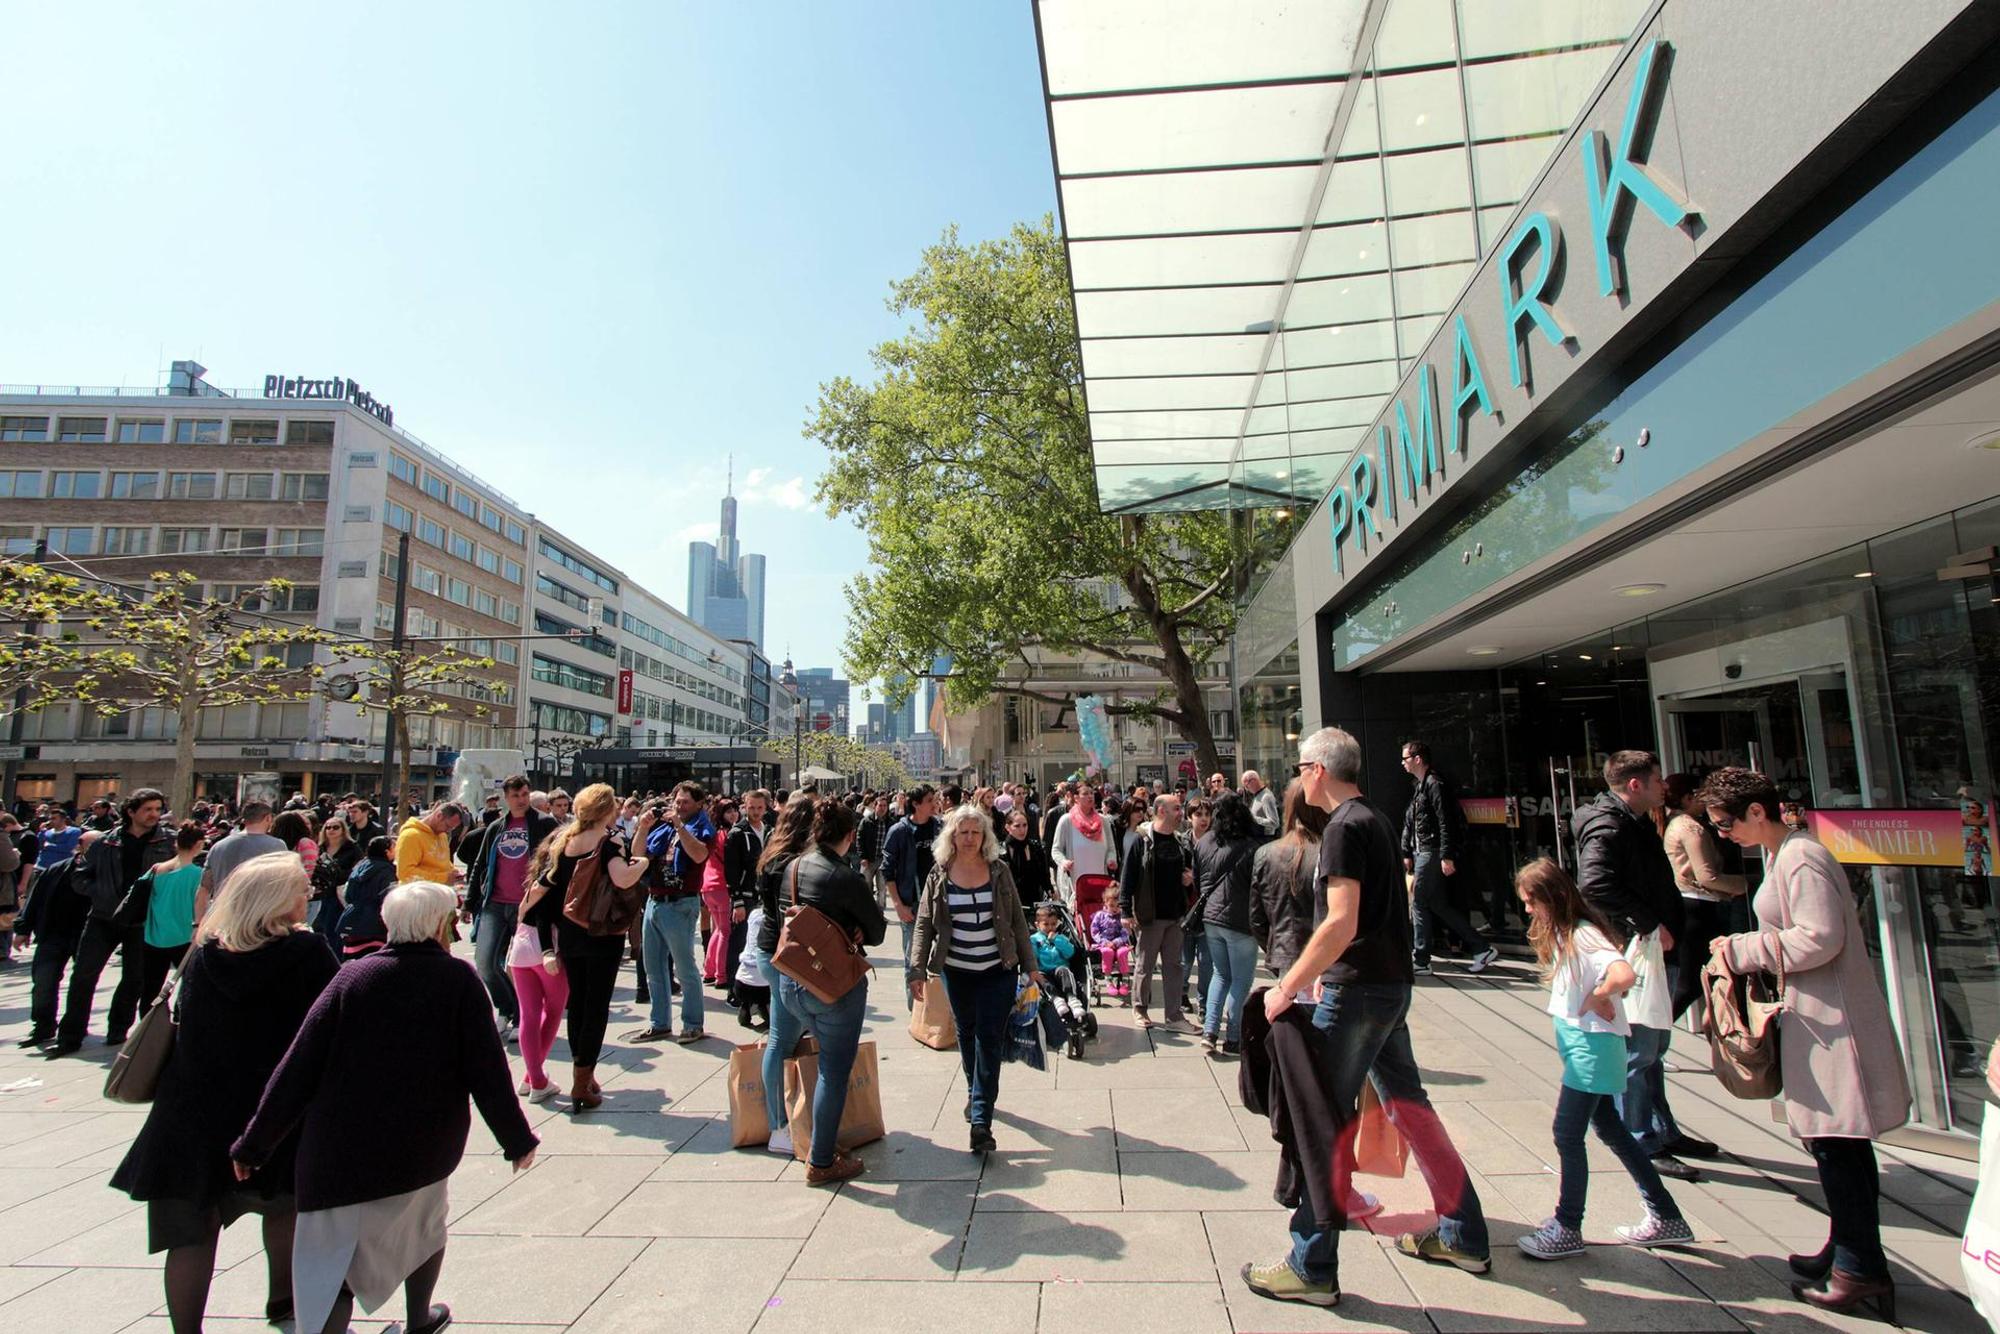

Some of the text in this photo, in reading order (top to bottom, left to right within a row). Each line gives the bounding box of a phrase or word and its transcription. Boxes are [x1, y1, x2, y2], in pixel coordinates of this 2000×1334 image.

[1329, 38, 1702, 574] PRIMARK
[1852, 819, 1909, 829] THE ENDLESS
[1833, 829, 1938, 857] SUMMER
